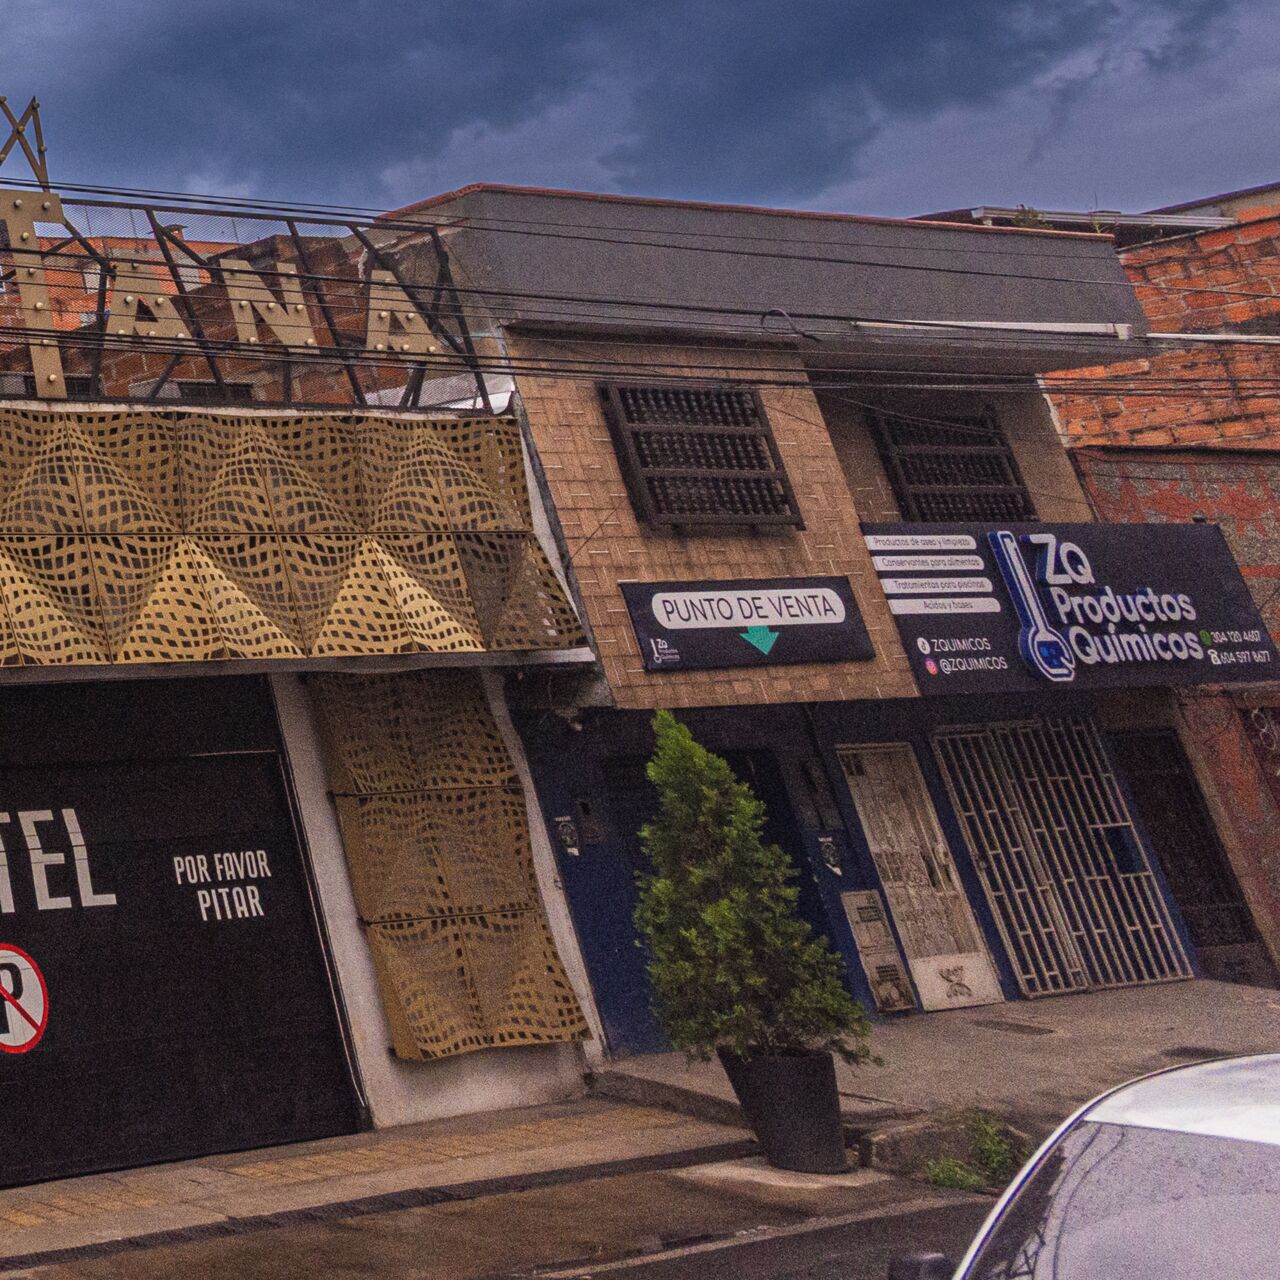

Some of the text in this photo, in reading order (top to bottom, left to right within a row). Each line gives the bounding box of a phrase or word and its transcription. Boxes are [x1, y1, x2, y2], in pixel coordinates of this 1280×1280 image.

[1029, 533, 1096, 584] ZQ
[662, 595, 837, 622] PUNTO DE VENTA
[1049, 585, 1197, 624] Productos
[931, 638, 991, 651] ZQUIMICOS
[940, 657, 1008, 674] @ZQUIMICOS
[173, 850, 272, 885] POR FAVOR
[197, 886, 264, 921] PITAR
